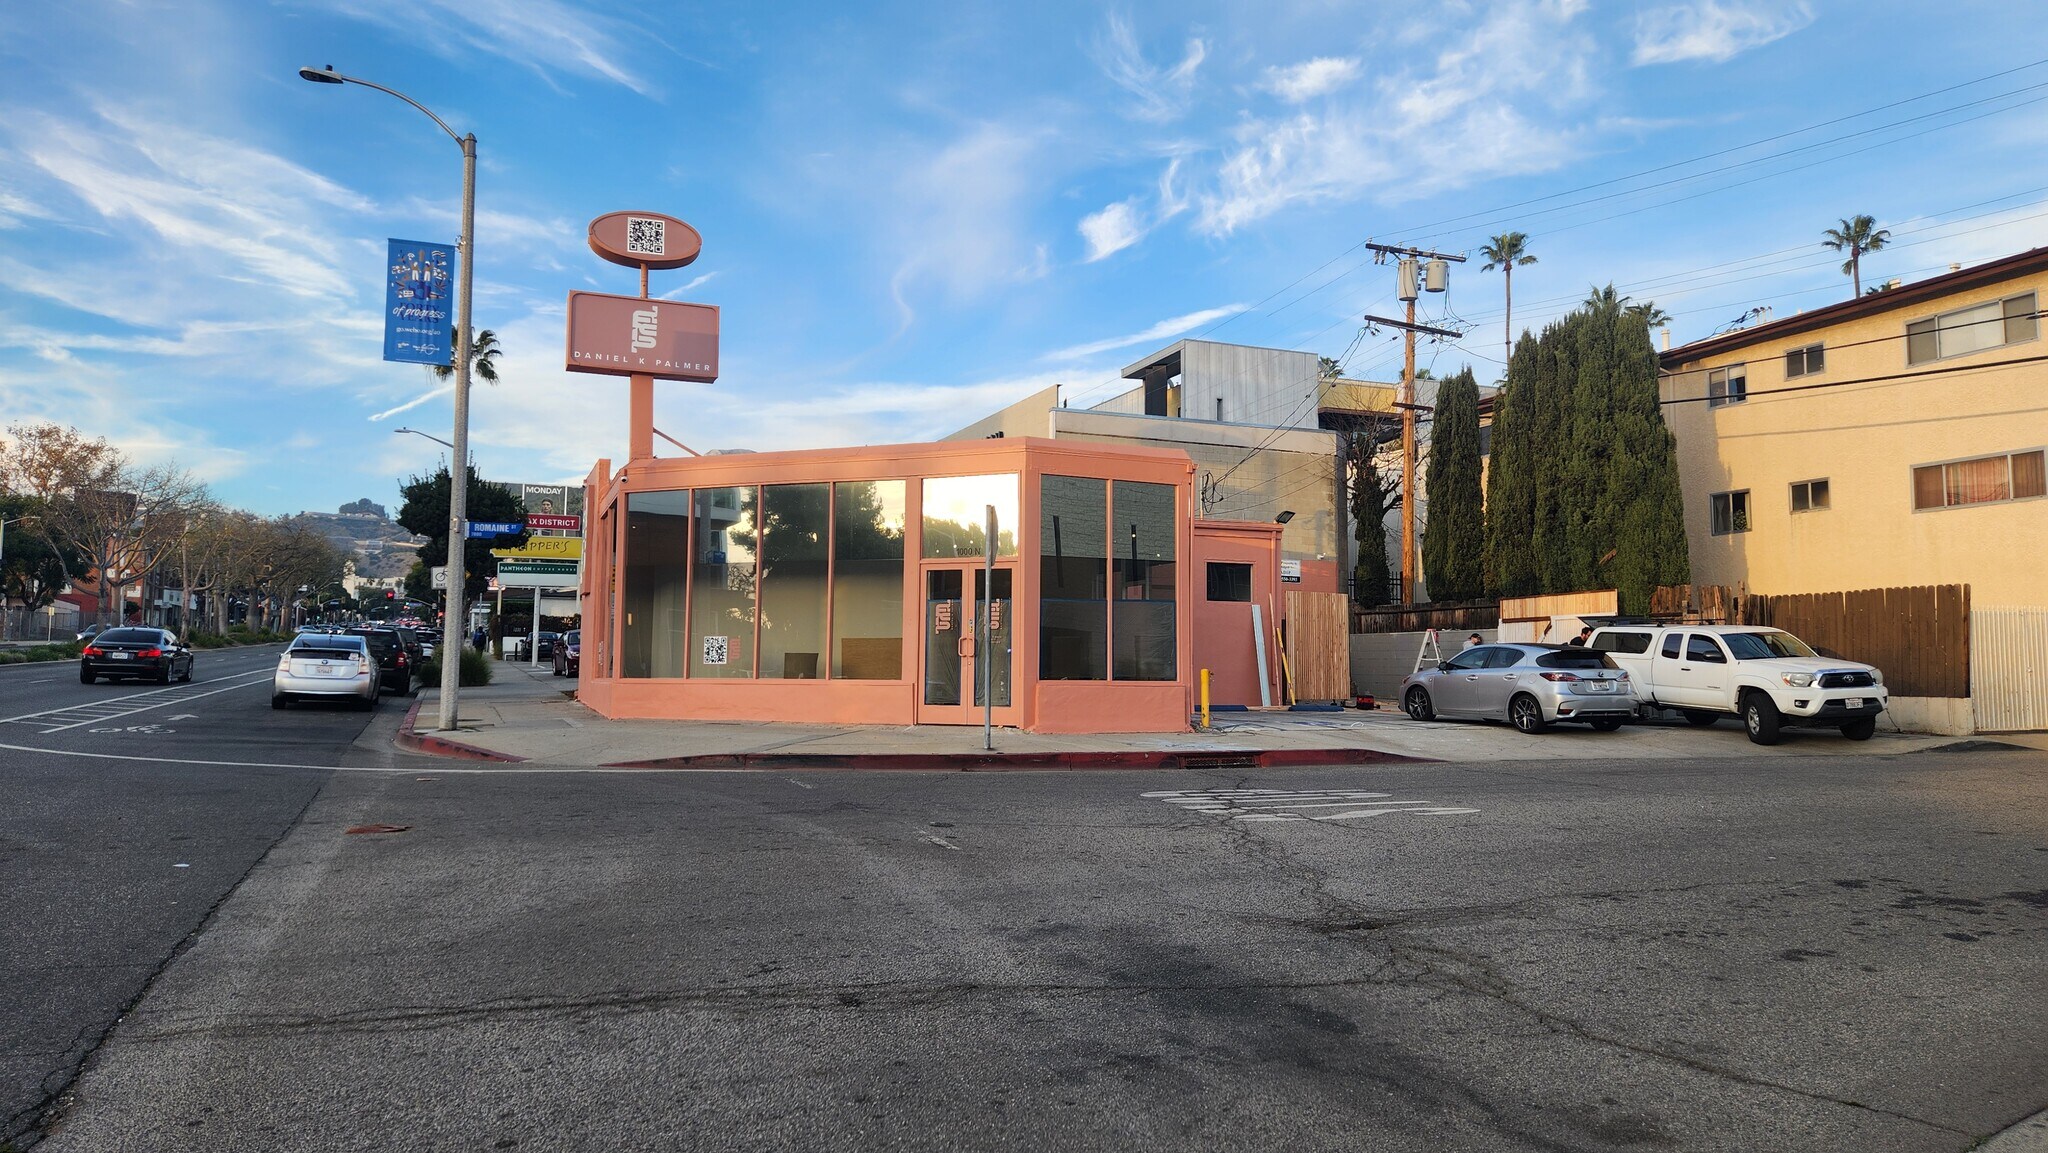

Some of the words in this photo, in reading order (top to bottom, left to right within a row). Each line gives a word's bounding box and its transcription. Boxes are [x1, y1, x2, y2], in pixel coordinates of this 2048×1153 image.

[392, 305, 406, 317] of
[404, 308, 446, 319] progress
[574, 350, 628, 363] DANIEL
[639, 357, 645, 365] K
[655, 358, 711, 371] PALMER
[526, 486, 563, 495] MONDAY
[539, 518, 576, 527] DISTRICT
[474, 523, 510, 532] ROMAINE
[956, 547, 973, 556] 1000
[974, 547, 981, 556] N
